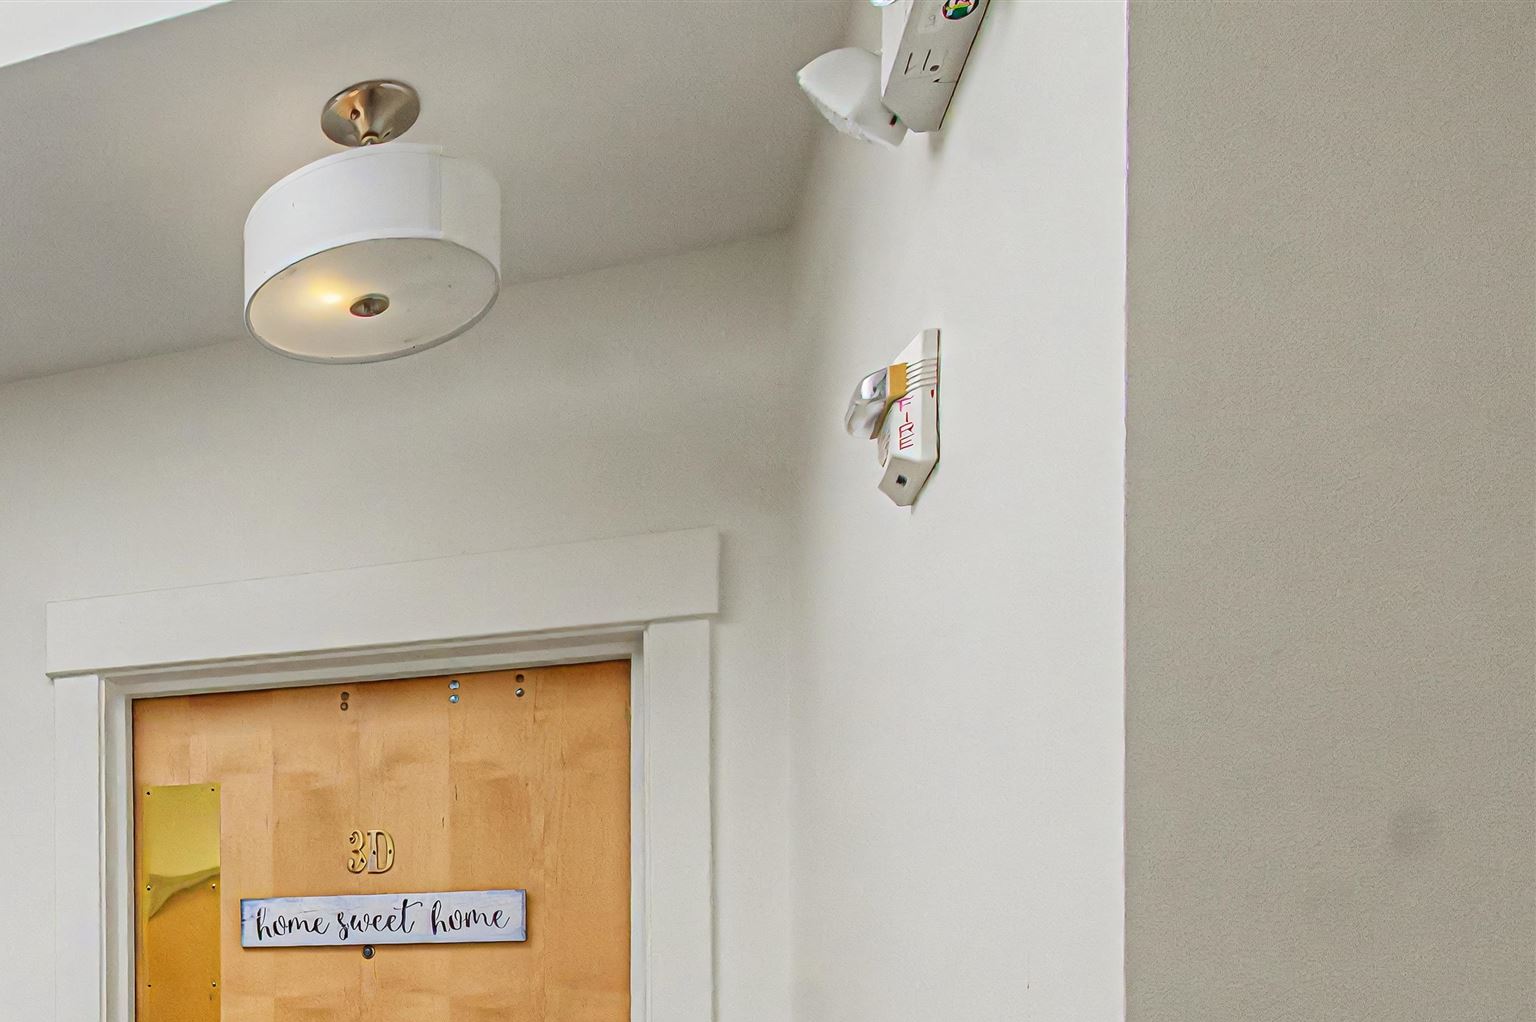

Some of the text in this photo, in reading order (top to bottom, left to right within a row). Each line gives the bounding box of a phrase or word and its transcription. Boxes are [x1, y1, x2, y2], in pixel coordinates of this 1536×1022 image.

[896, 396, 914, 450] FIRE
[347, 829, 395, 874] 3D
[256, 898, 510, 941] home sweet home
